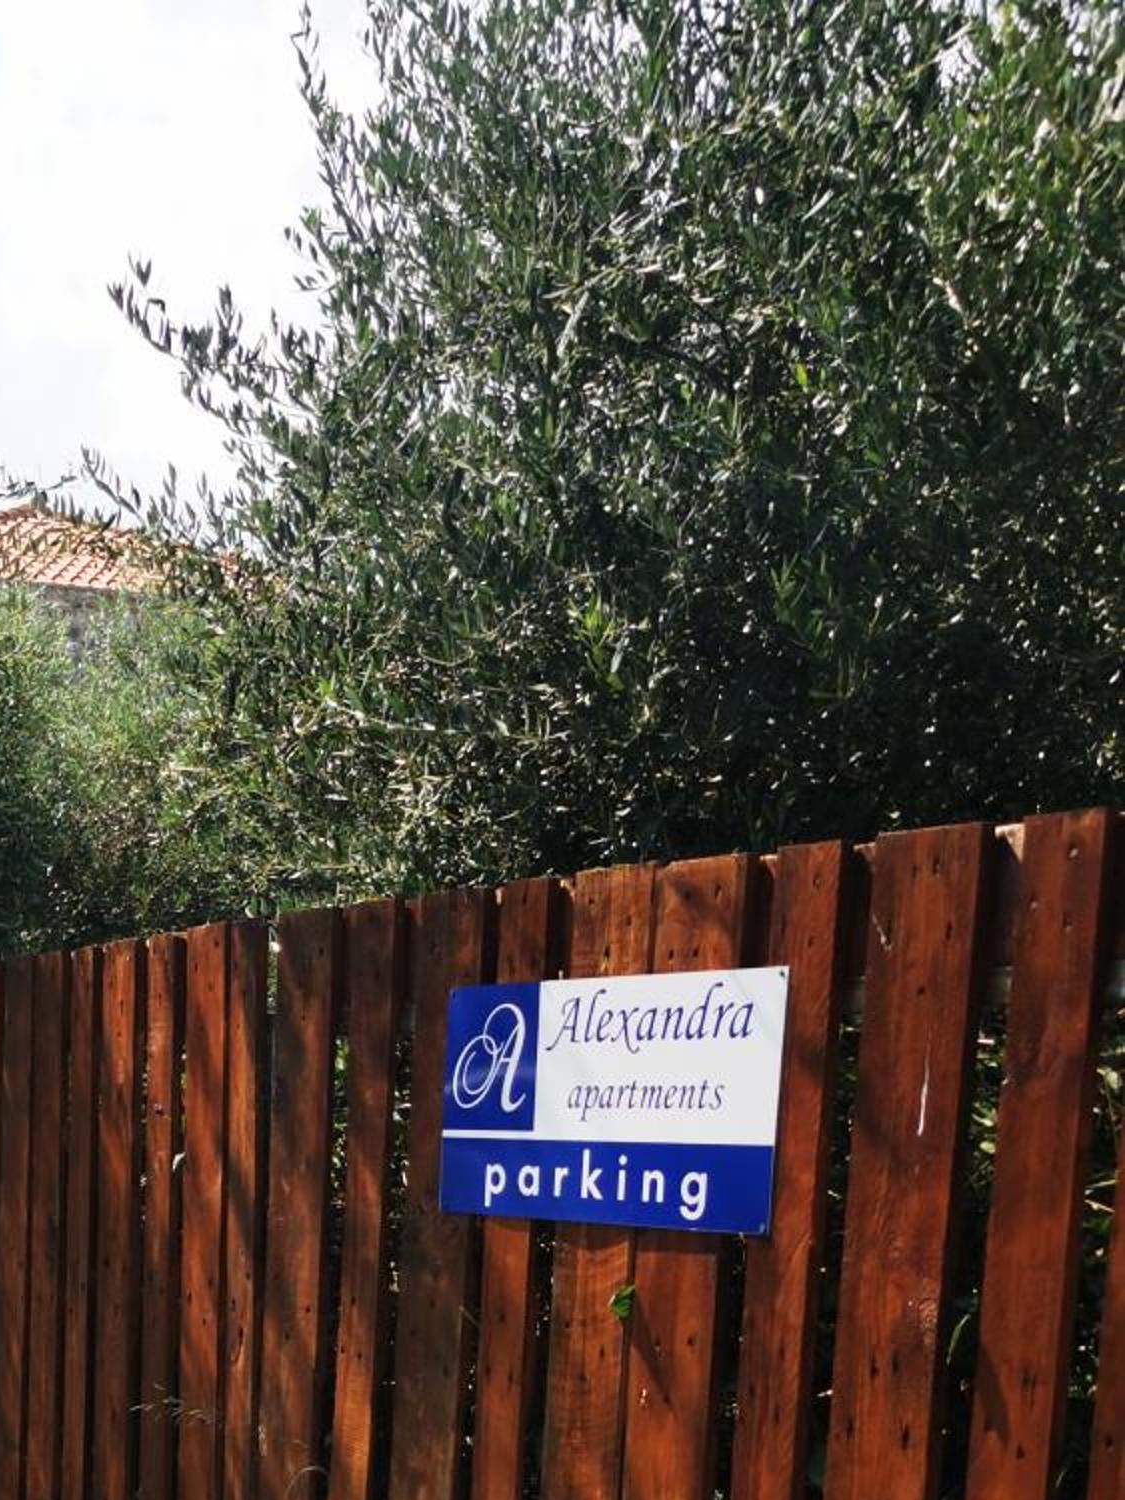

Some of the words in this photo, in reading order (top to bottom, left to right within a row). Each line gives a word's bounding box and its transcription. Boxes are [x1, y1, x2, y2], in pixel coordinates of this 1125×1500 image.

[546, 982, 755, 1053] Alexandra
[452, 1003, 526, 1113] A
[567, 1079, 725, 1121] apartments
[484, 1148, 708, 1221] parking
